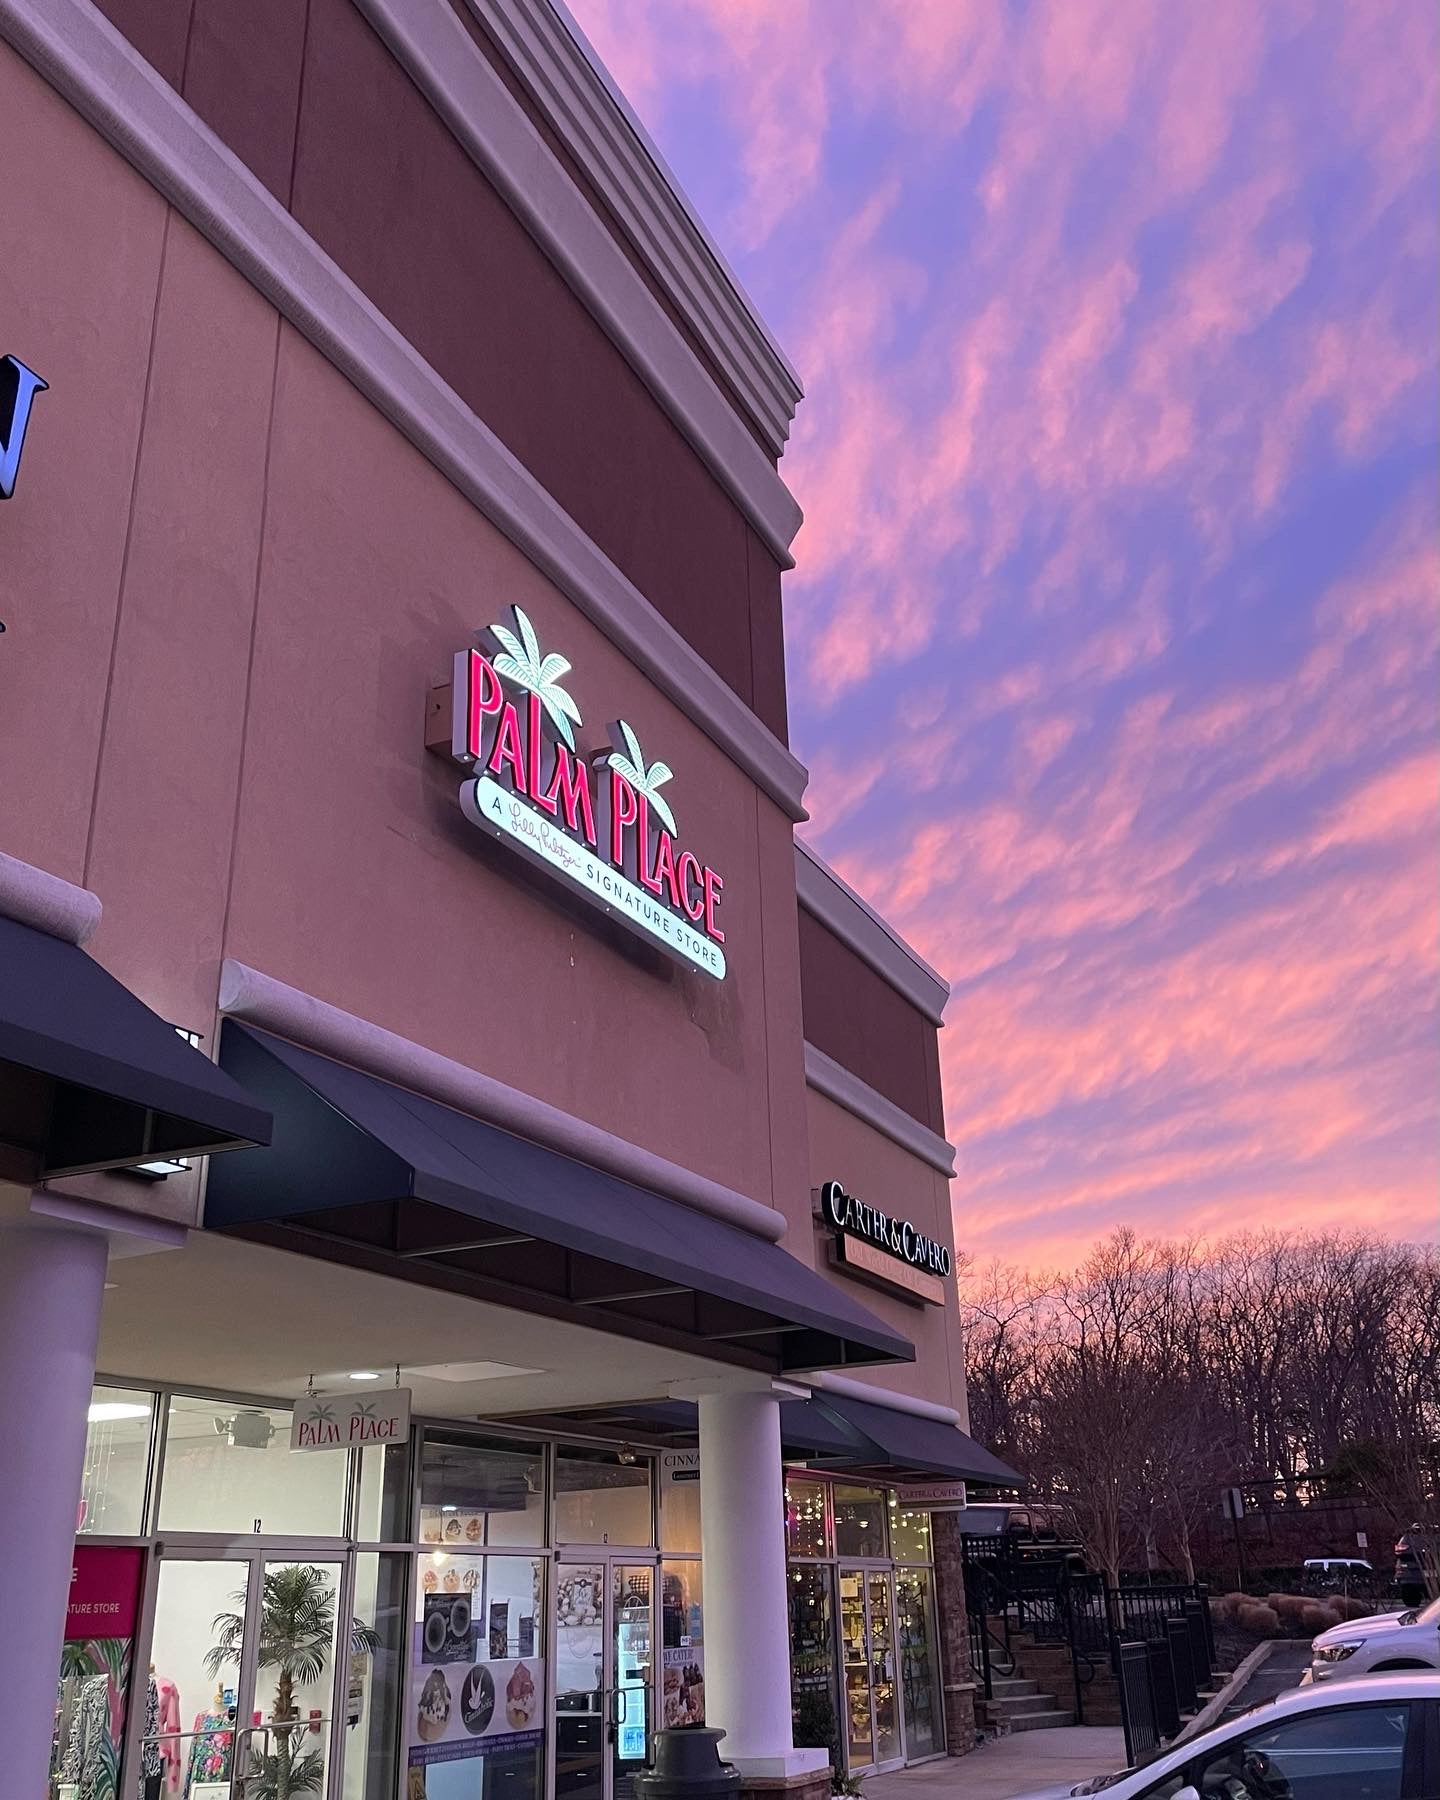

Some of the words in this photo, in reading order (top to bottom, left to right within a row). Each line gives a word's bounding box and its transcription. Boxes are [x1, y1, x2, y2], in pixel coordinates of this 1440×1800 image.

[467, 648, 598, 847] PALM
[611, 768, 726, 944] PLACE
[491, 796, 503, 815] A
[586, 863, 671, 935] SIGNATURE
[676, 928, 718, 968] STORE
[830, 1180, 890, 1247] CARTER
[902, 1221, 951, 1277] CAVERO
[298, 1418, 341, 1447] PALM
[349, 1416, 400, 1441] PLACE
[253, 1519, 262, 1533] 12
[68, 1603, 92, 1614] TURE
[93, 1602, 121, 1614] STORE
